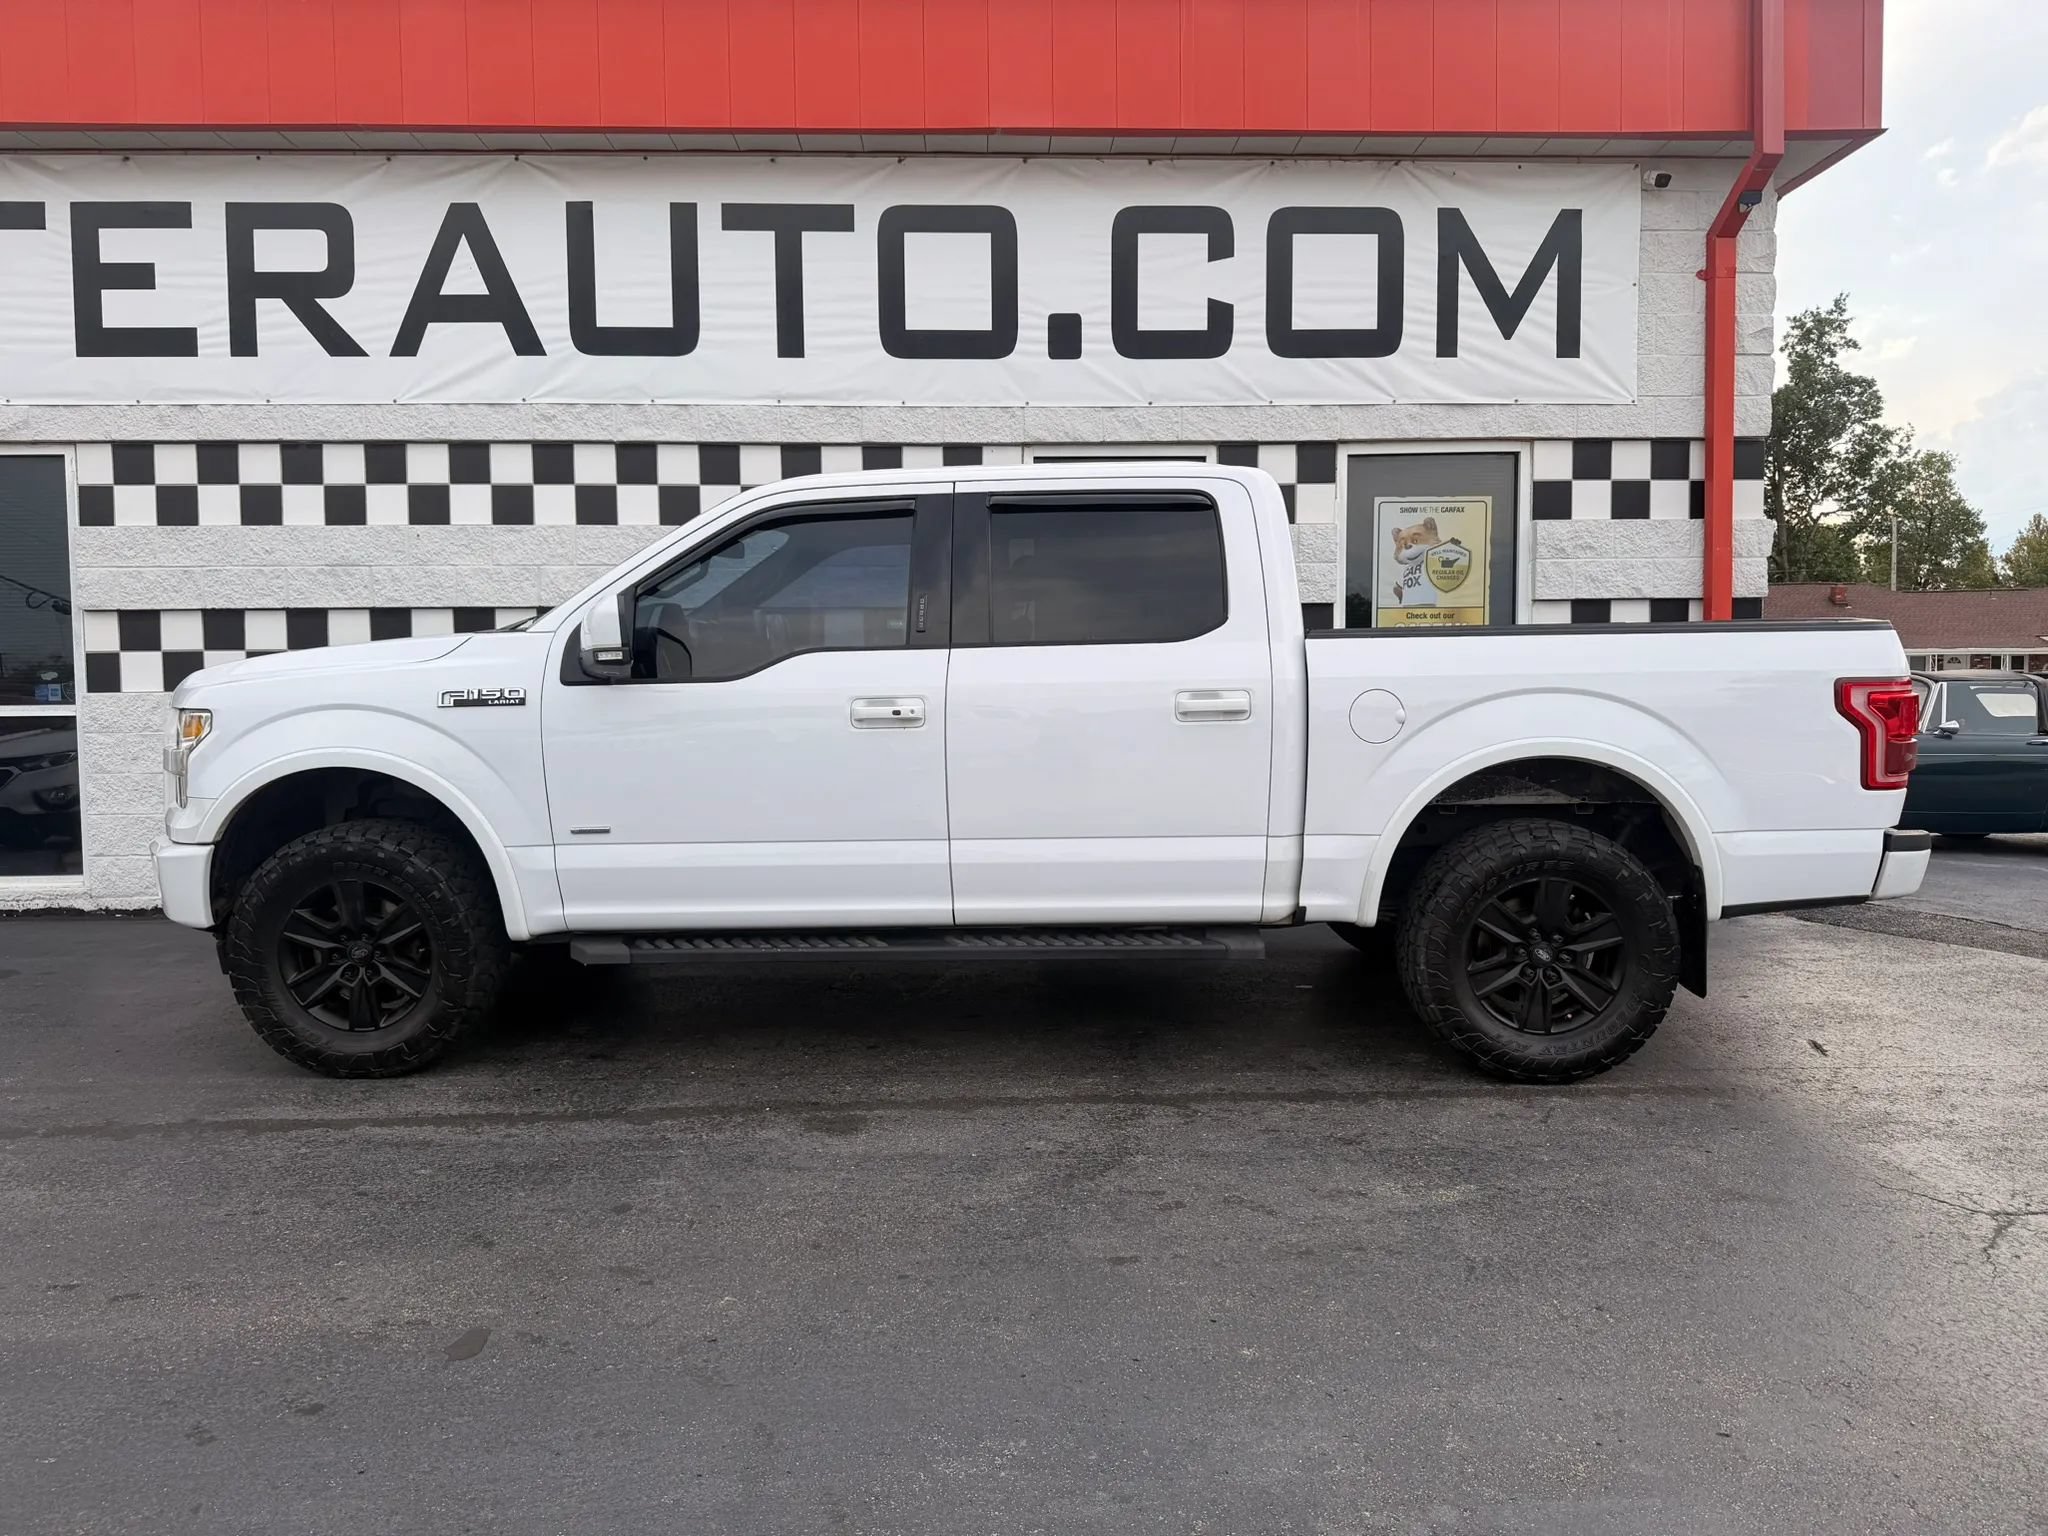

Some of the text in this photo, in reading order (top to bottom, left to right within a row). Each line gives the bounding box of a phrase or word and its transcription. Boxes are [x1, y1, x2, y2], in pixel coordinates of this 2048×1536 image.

[1400, 506, 1418, 514] SHOW
[1403, 564, 1422, 578] CAR
[1402, 575, 1422, 589] FOX
[1406, 611, 1427, 619] Check
